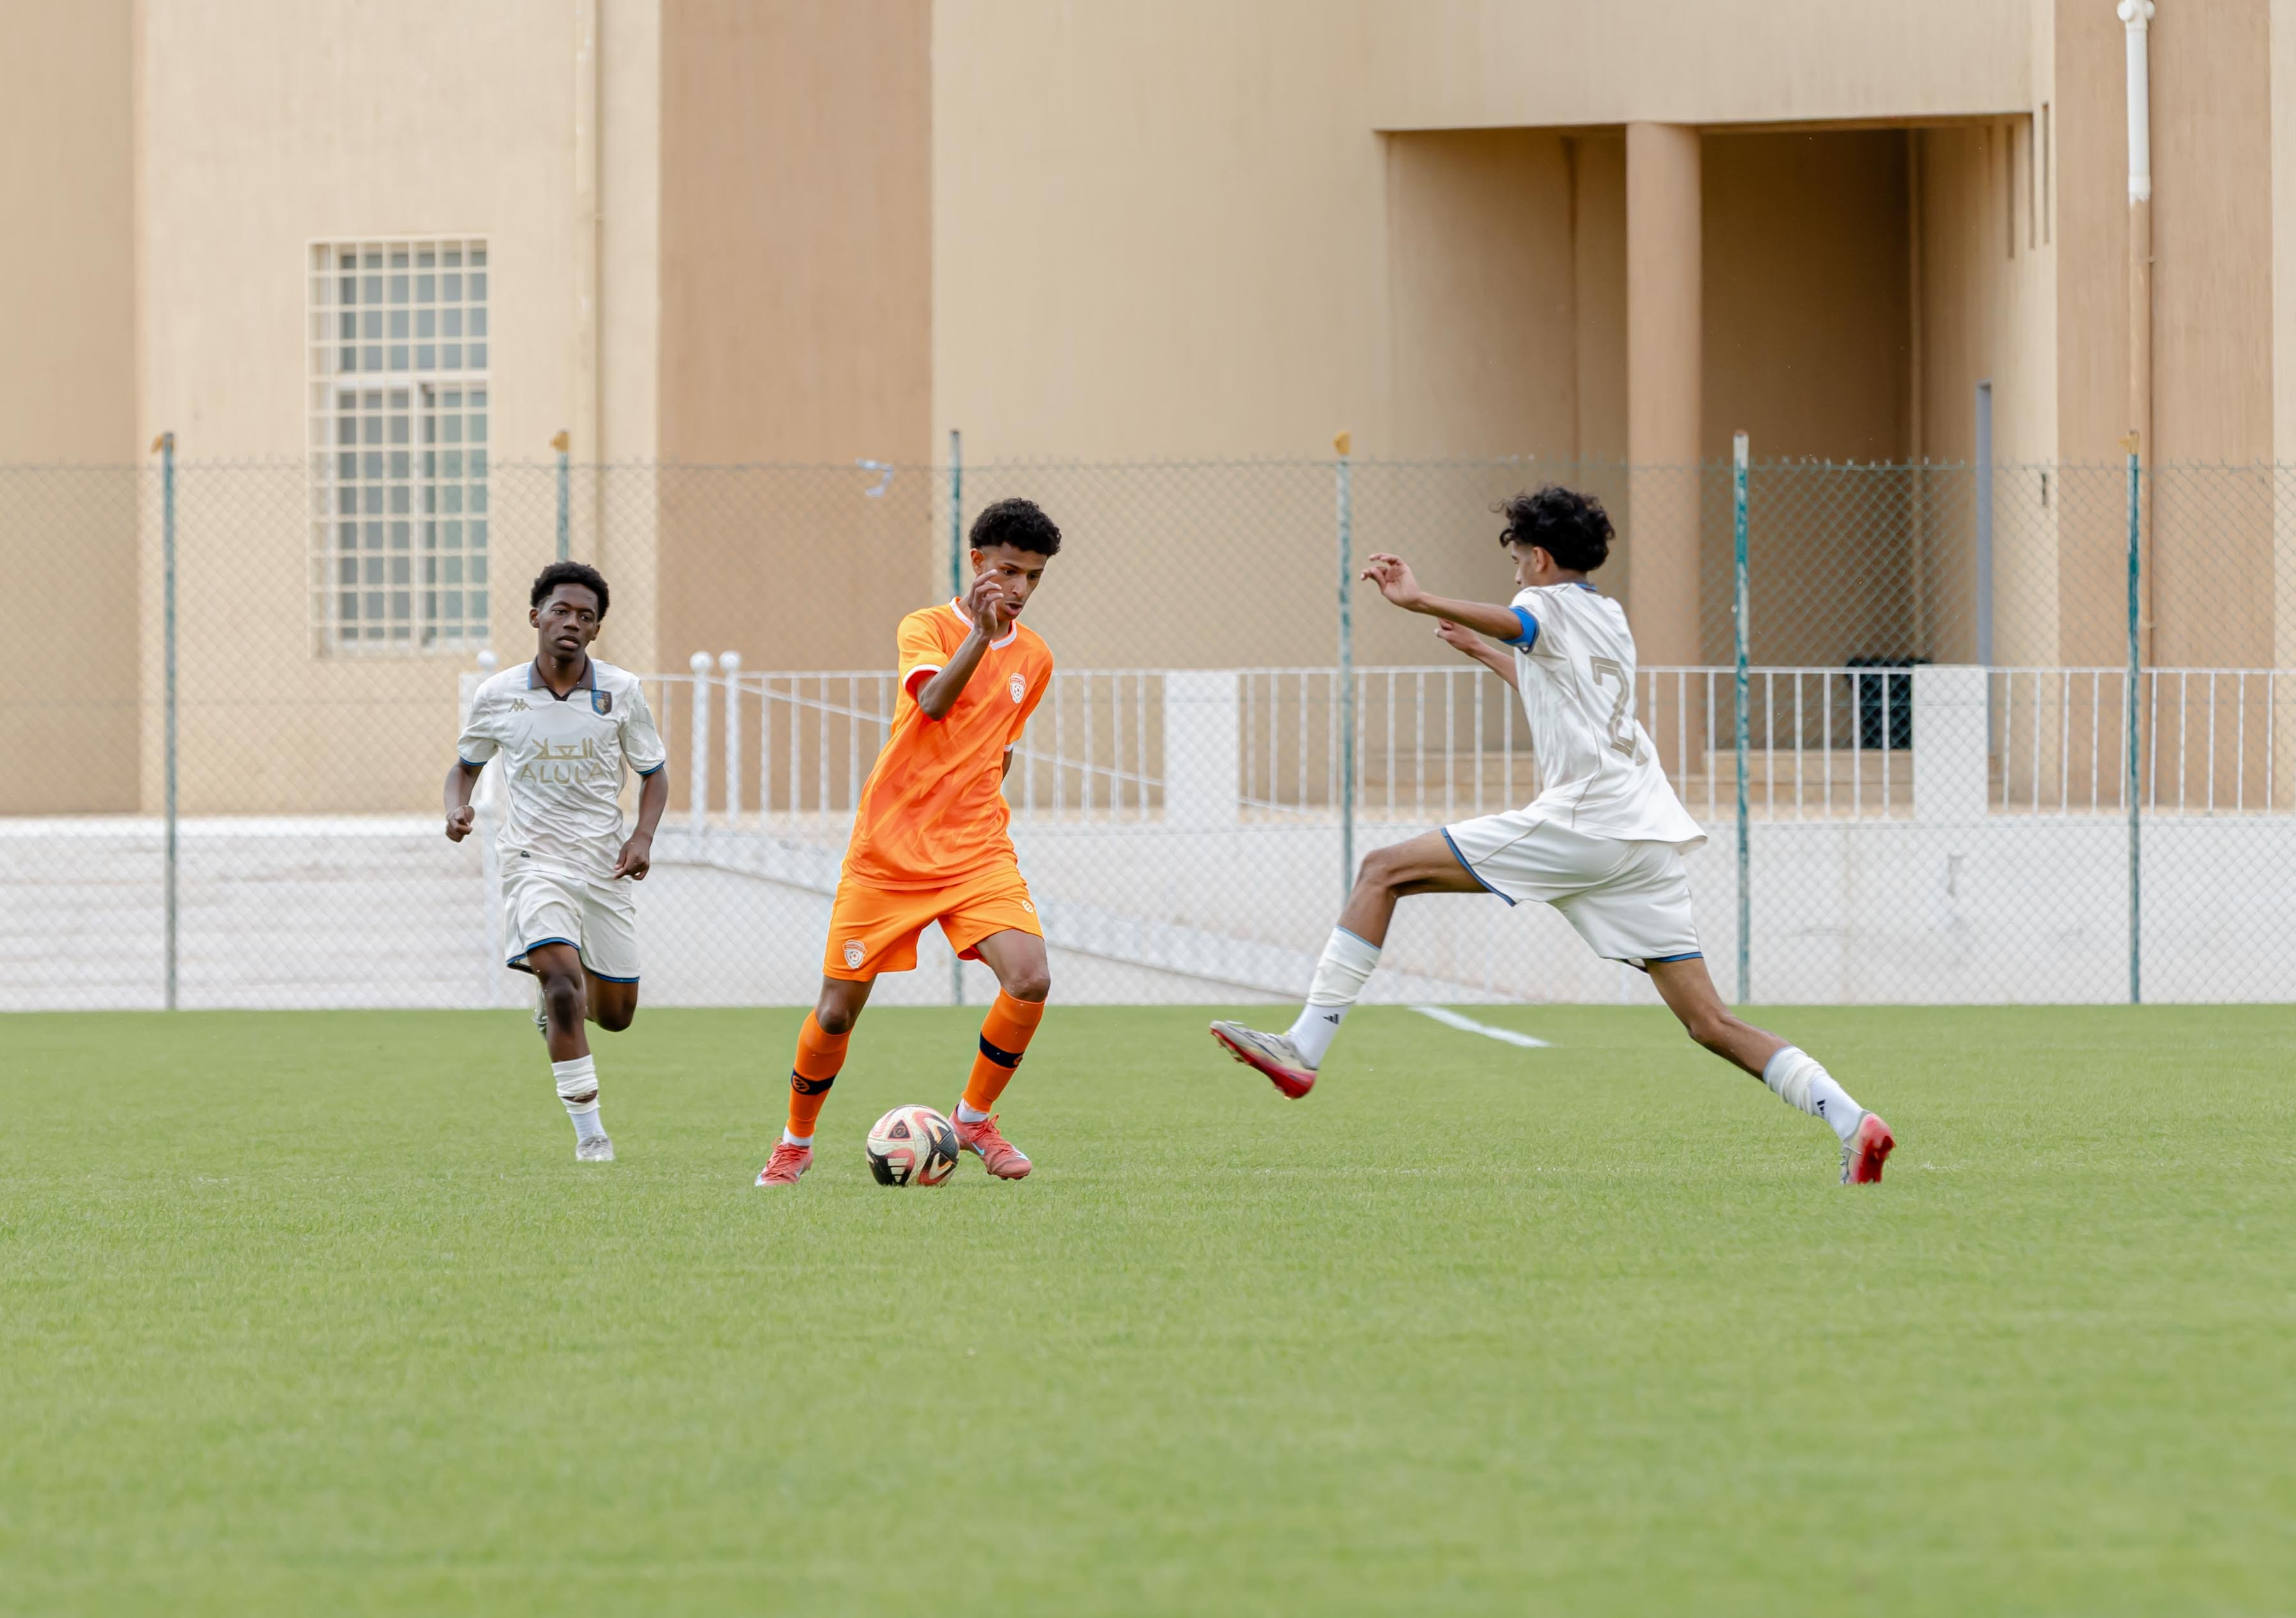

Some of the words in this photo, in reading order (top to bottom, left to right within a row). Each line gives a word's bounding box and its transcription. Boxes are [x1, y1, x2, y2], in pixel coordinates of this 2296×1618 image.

[1590, 656, 1648, 767] 2
[531, 737, 593, 760] العلا
[520, 762, 604, 786] ALULA
